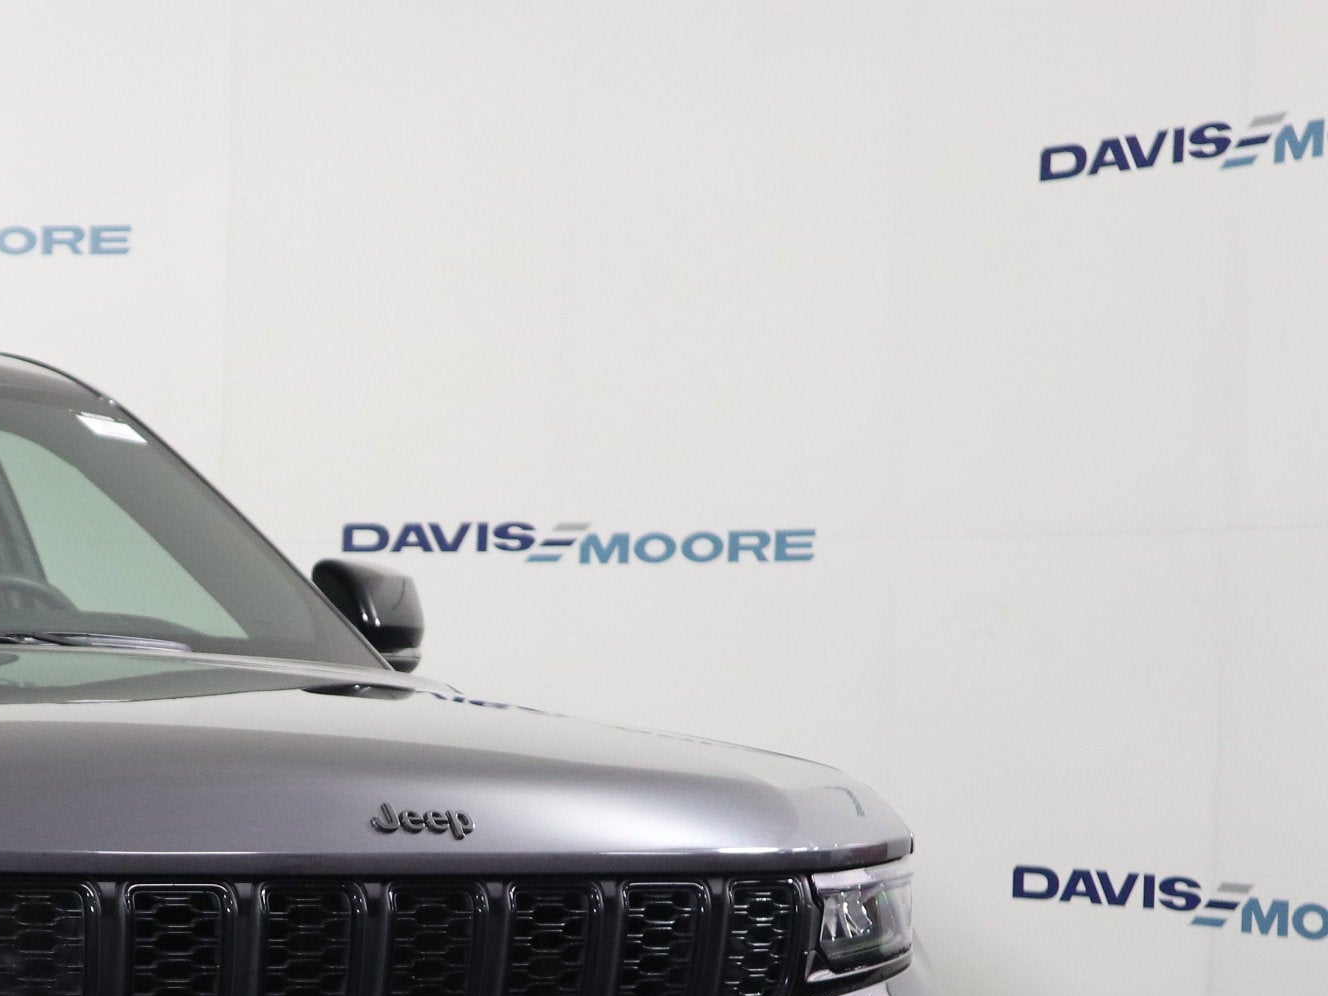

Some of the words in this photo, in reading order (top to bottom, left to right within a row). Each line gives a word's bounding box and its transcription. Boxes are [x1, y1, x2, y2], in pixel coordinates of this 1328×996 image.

[1039, 122, 1232, 182] DAVIS
[341, 521, 536, 553] DAVIS
[578, 529, 816, 564] MOORE
[370, 802, 476, 840] Jeep
[1012, 865, 1202, 912] DAVIS
